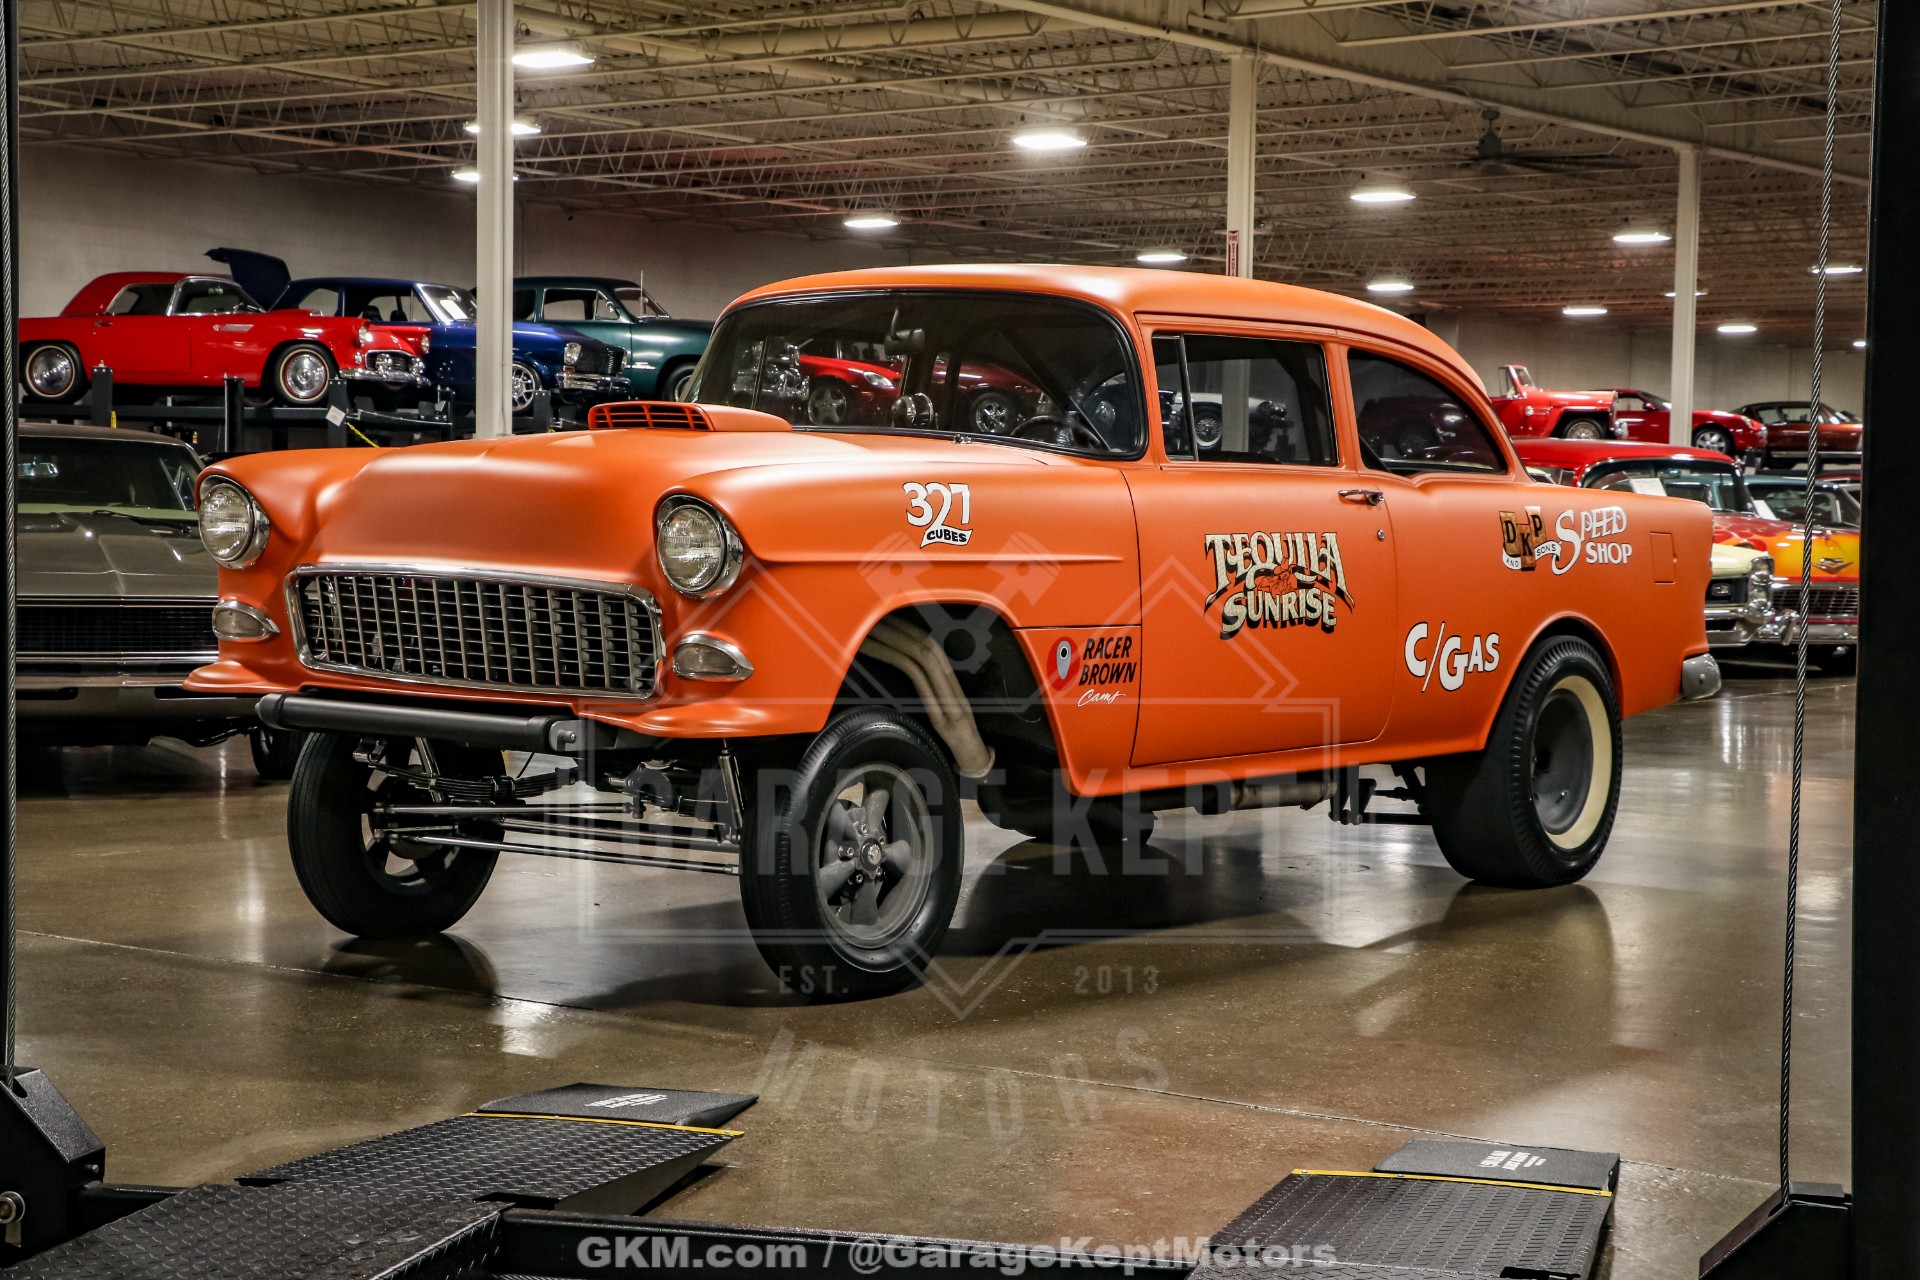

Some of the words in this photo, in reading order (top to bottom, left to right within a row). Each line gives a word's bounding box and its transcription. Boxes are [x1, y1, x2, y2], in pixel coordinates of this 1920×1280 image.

[902, 481, 971, 532] 327
[926, 528, 967, 543] CUBES
[1505, 555, 1519, 568] AND
[1536, 543, 1557, 557] SONS
[1585, 541, 1633, 565] SHOP
[1203, 531, 1355, 607] TEQUILA
[1219, 588, 1337, 639] SUNRISE
[1083, 635, 1132, 661] RACER
[1404, 621, 1500, 692] C/GAS
[1078, 662, 1137, 686] BROWN
